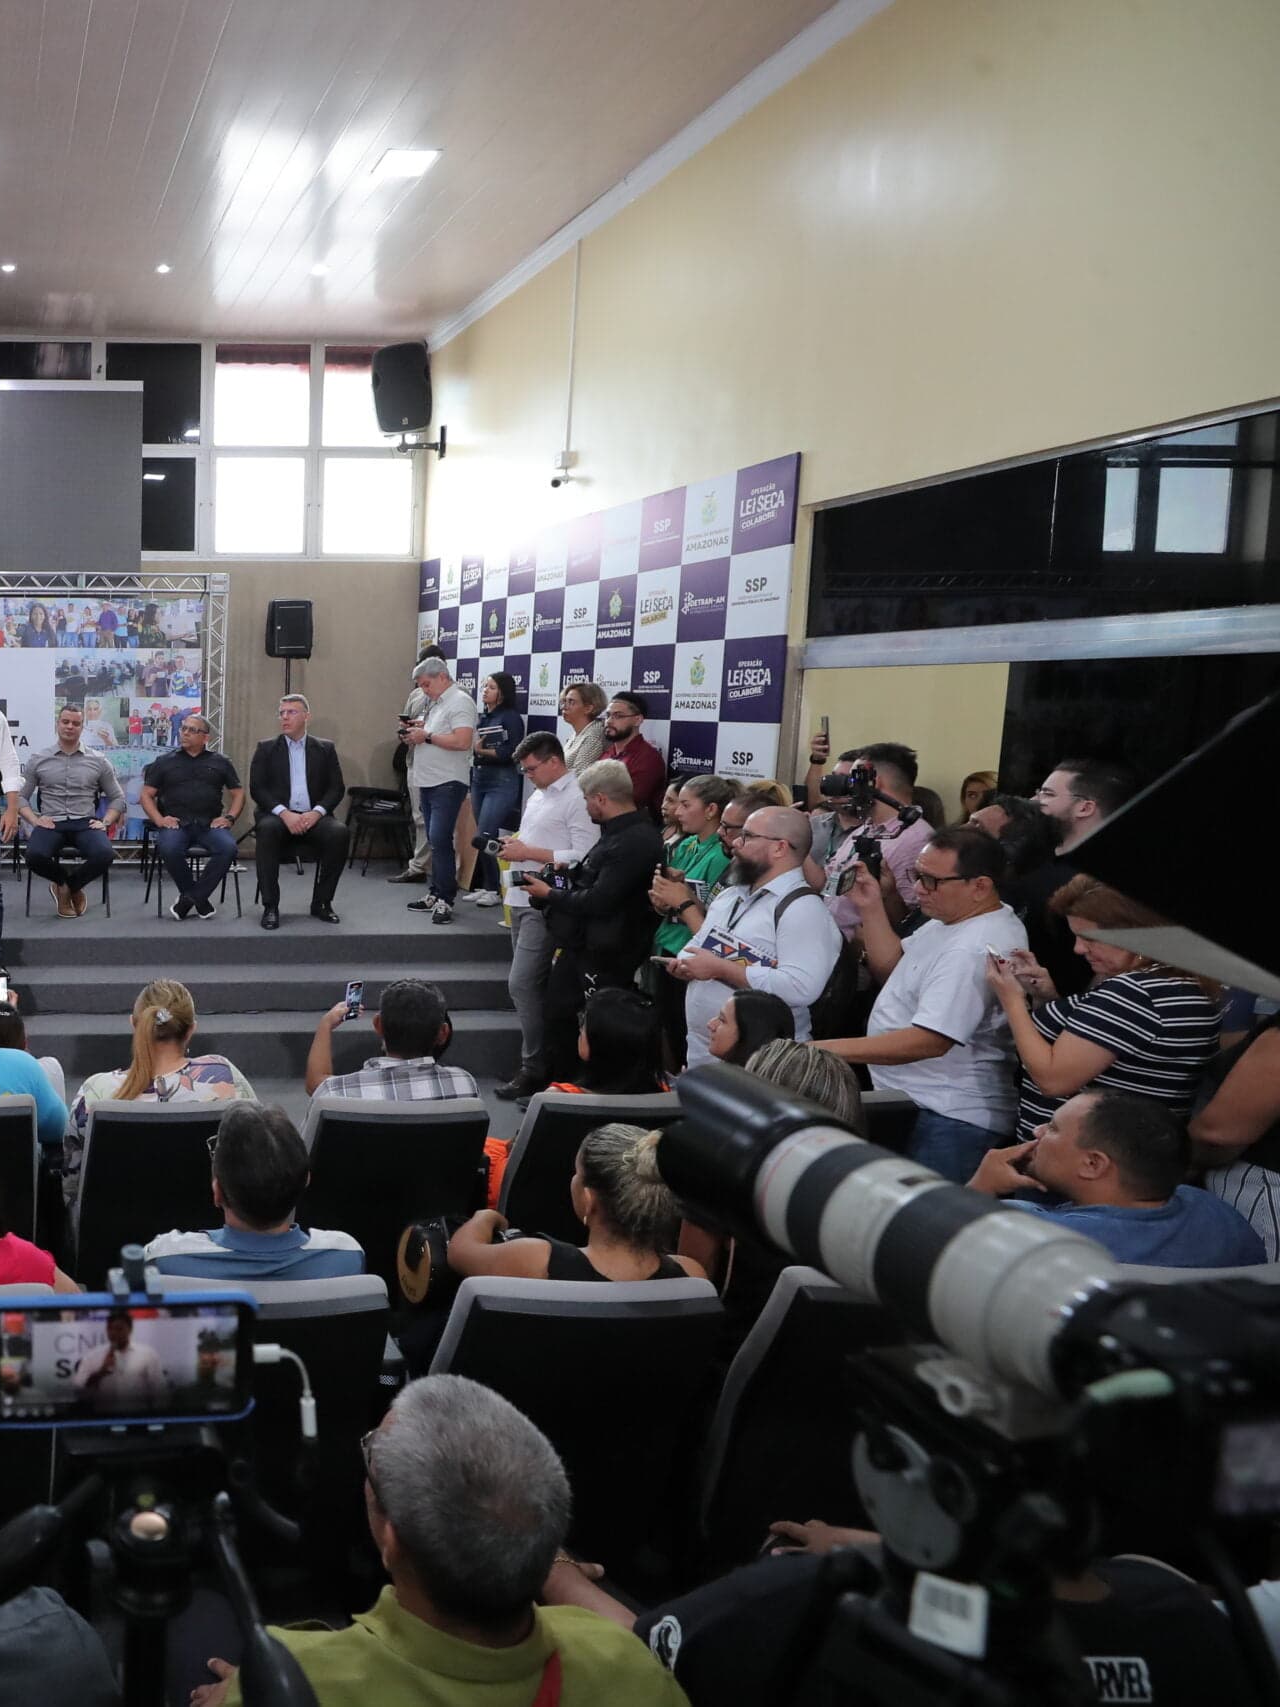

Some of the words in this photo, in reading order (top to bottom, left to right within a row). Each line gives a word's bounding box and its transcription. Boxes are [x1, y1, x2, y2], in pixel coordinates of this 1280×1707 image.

[740, 497, 756, 518] LEI
[756, 490, 785, 512] SECA
[653, 519, 672, 534] SSP
[742, 511, 776, 529] COLABORE
[685, 536, 729, 552] AMAZONAS
[745, 577, 768, 593] SSP
[573, 607, 587, 620] SSP
[597, 628, 631, 639] AMAZONAS
[643, 671, 661, 684] SSP
[728, 669, 744, 687] LEI
[743, 668, 771, 686] SECA
[729, 686, 763, 699] COLABORE
[674, 701, 717, 710] AMAZONAS
[732, 751, 754, 766] SSP
